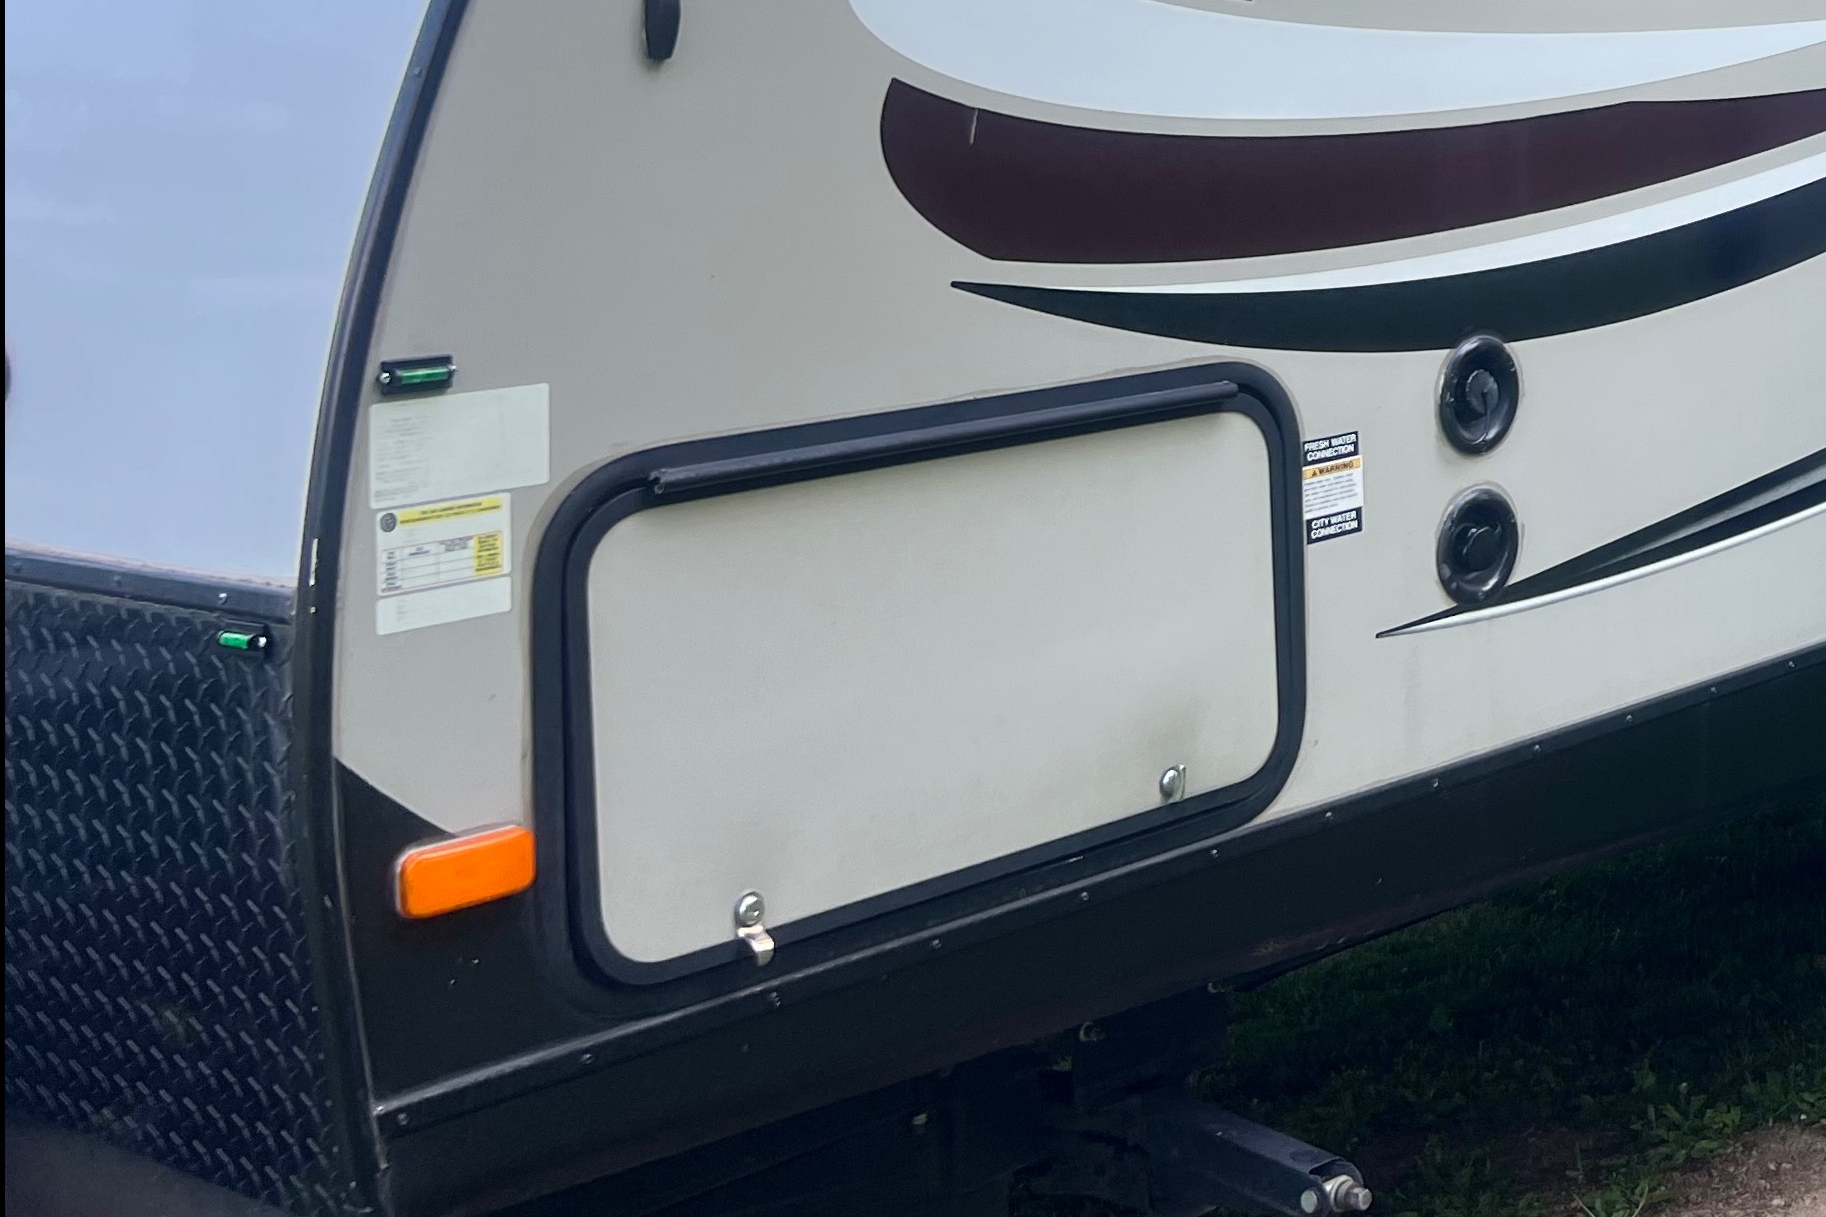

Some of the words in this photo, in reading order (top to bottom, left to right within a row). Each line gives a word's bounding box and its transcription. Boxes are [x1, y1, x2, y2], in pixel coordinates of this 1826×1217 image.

[1305, 439, 1329, 452] FRESH
[1331, 434, 1356, 445] WATER
[1307, 444, 1354, 461] CONNECTION
[1319, 460, 1354, 474] WARNING
[1311, 518, 1329, 529] CITY
[1330, 511, 1356, 524] WATER
[1311, 520, 1358, 539] CONNECTION
